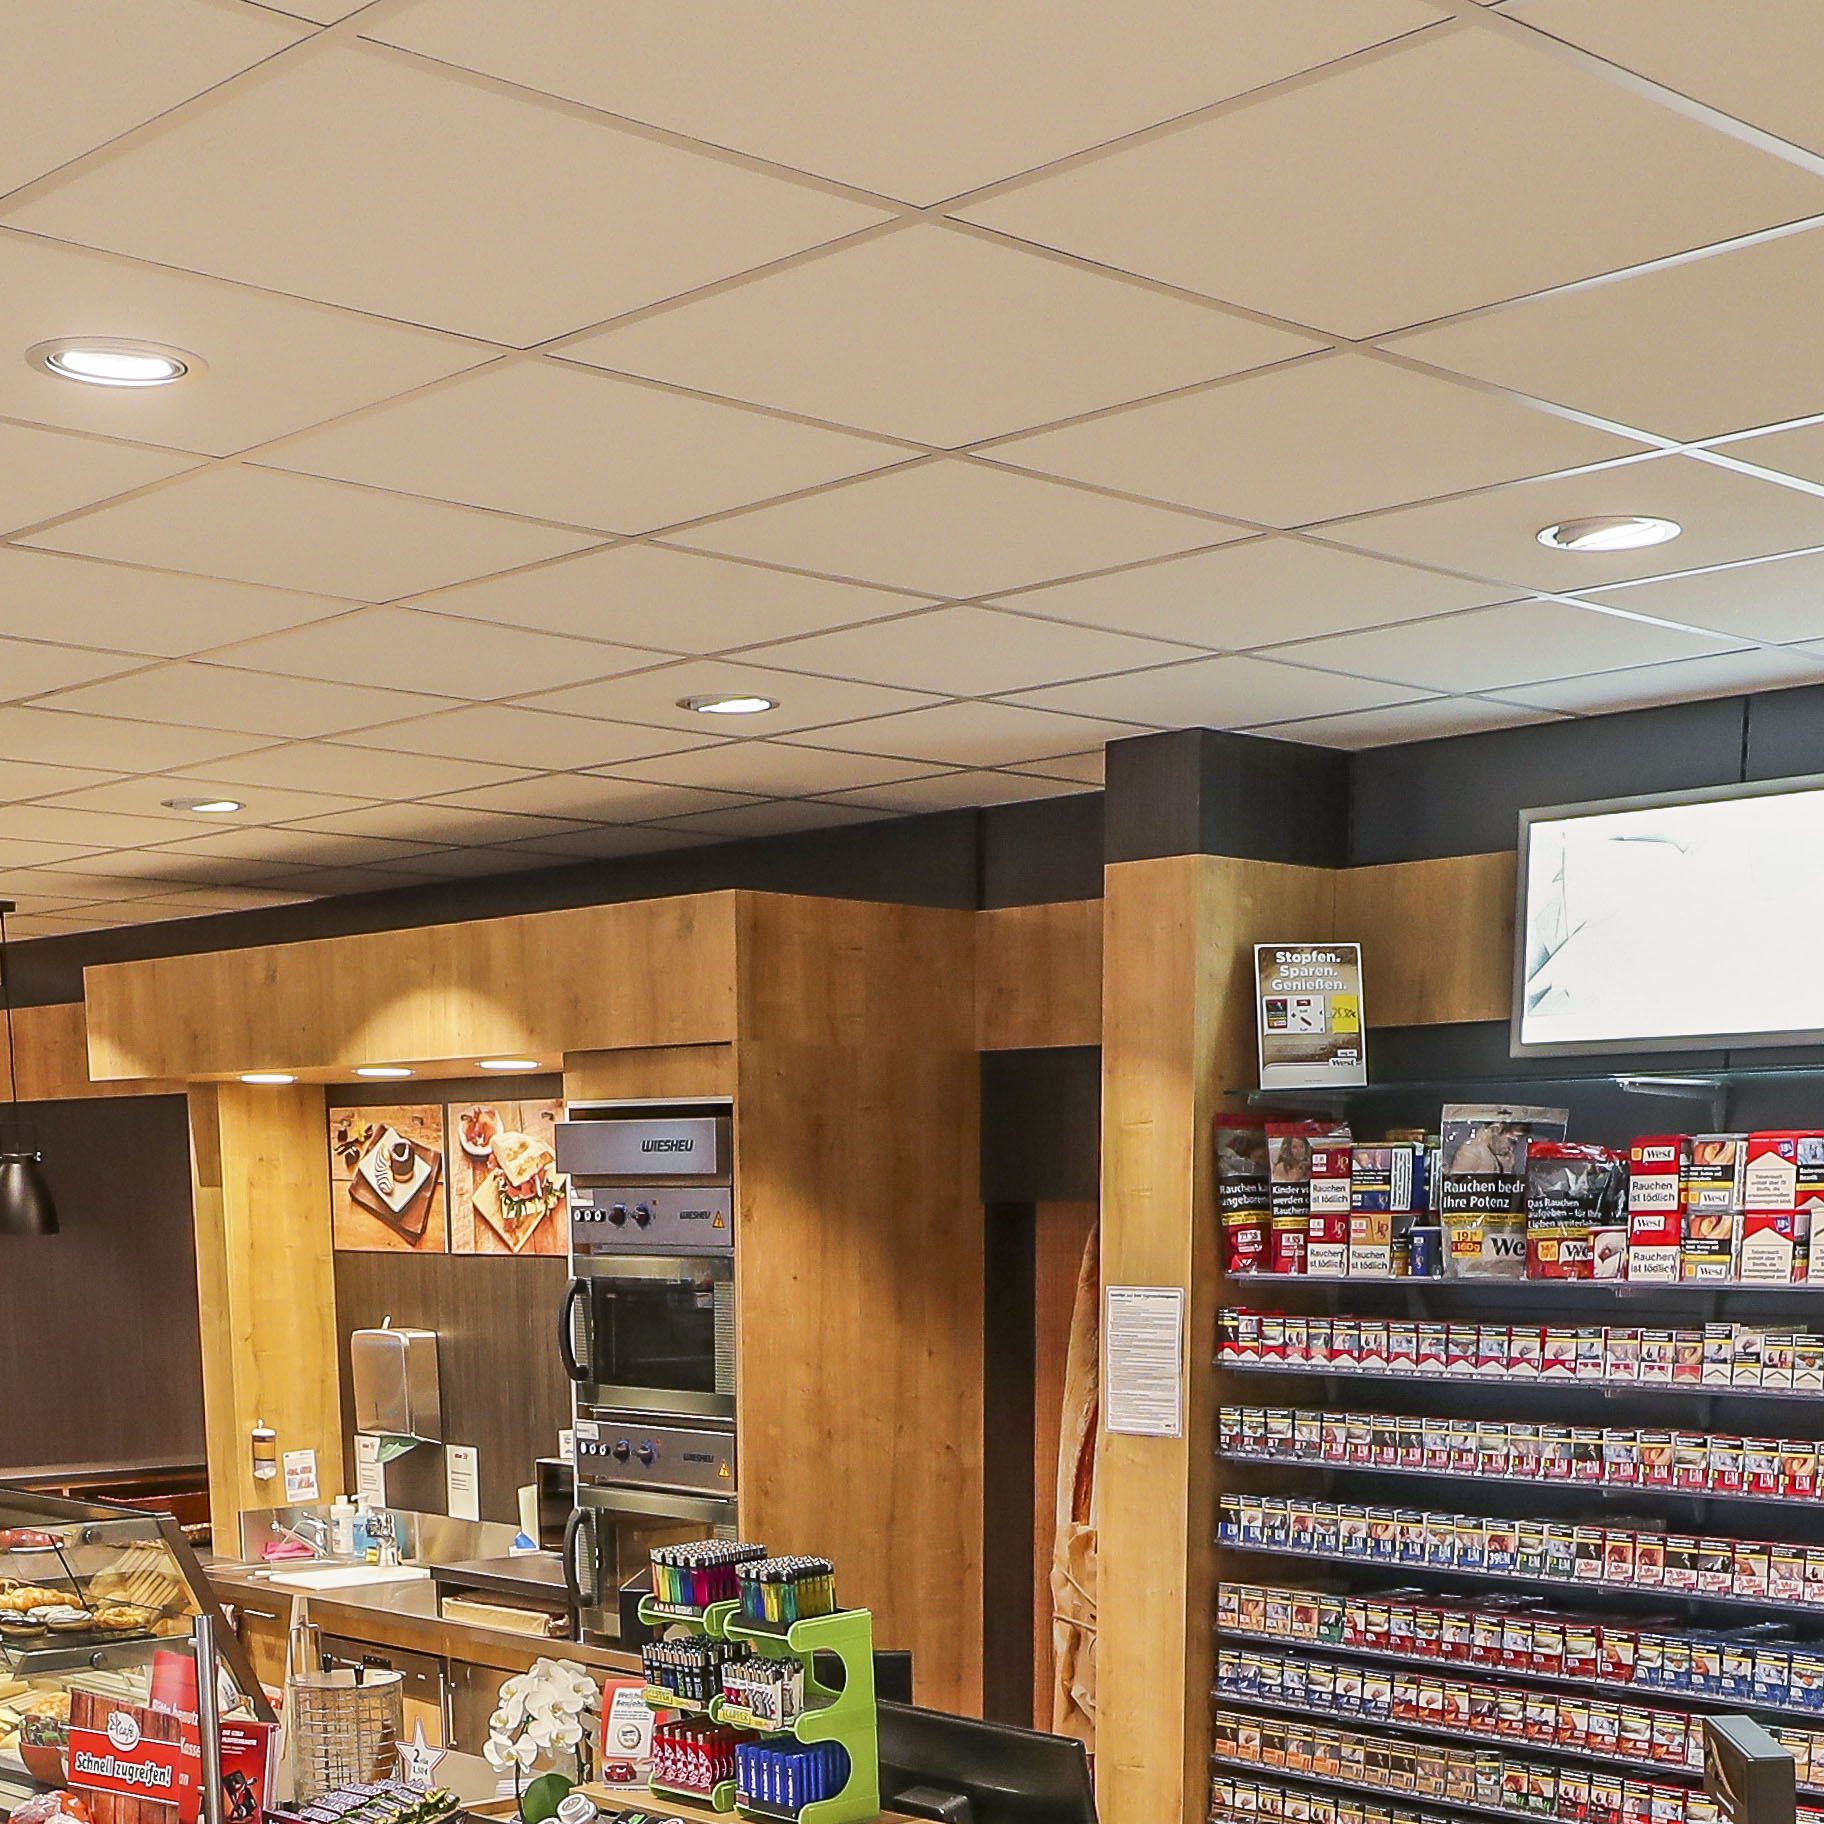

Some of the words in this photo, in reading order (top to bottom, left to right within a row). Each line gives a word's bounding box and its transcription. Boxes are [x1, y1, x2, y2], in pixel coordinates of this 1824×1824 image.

[1276, 951, 1341, 964] Stopfen.
[1280, 966, 1338, 978] Sparen.
[1272, 979, 1347, 990] Genießen.
[1647, 1149, 1673, 1159] West
[1444, 1181, 1496, 1193] Rauchen
[1498, 1180, 1525, 1192] bedr
[1633, 1182, 1673, 1190] Rauchen
[1444, 1197, 1467, 1208] Ihre
[1470, 1197, 1509, 1209] Potenz
[1643, 1192, 1675, 1202] tödlich
[76, 1752, 113, 1774] Schnell
[114, 1761, 172, 1788] zugreifen!
